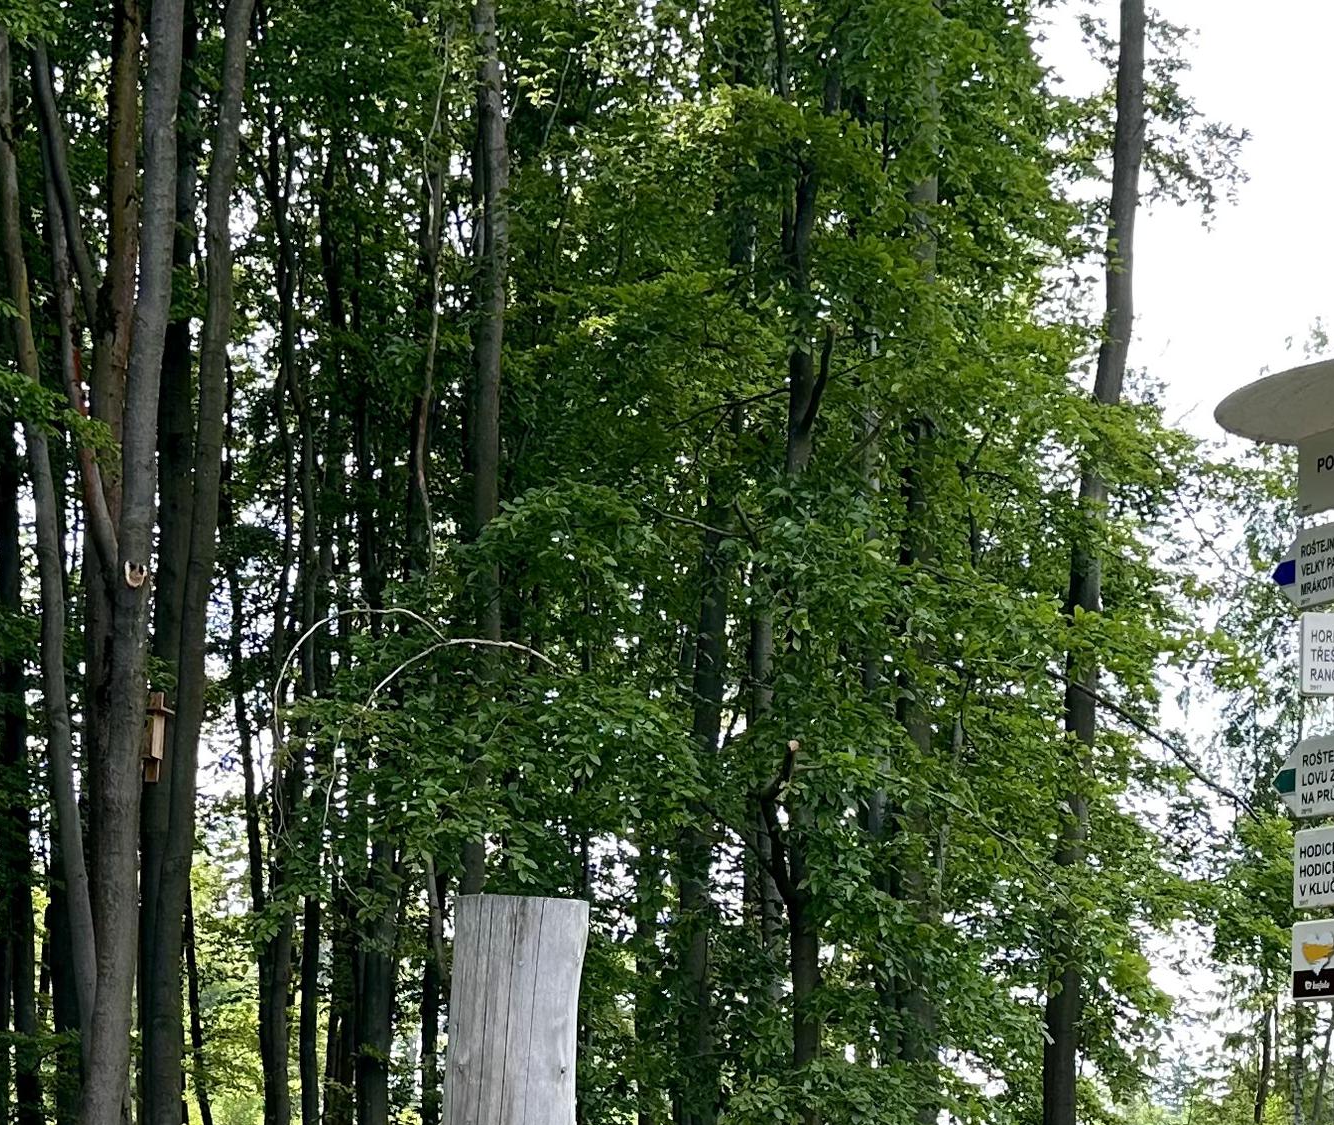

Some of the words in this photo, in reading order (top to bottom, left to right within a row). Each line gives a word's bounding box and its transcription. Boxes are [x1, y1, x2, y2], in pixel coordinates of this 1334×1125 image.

[1301, 556, 1325, 577] VELKÝ
[1301, 769, 1327, 787] LOVU
[1301, 792, 1315, 805] NA
[1300, 884, 1306, 896] V
